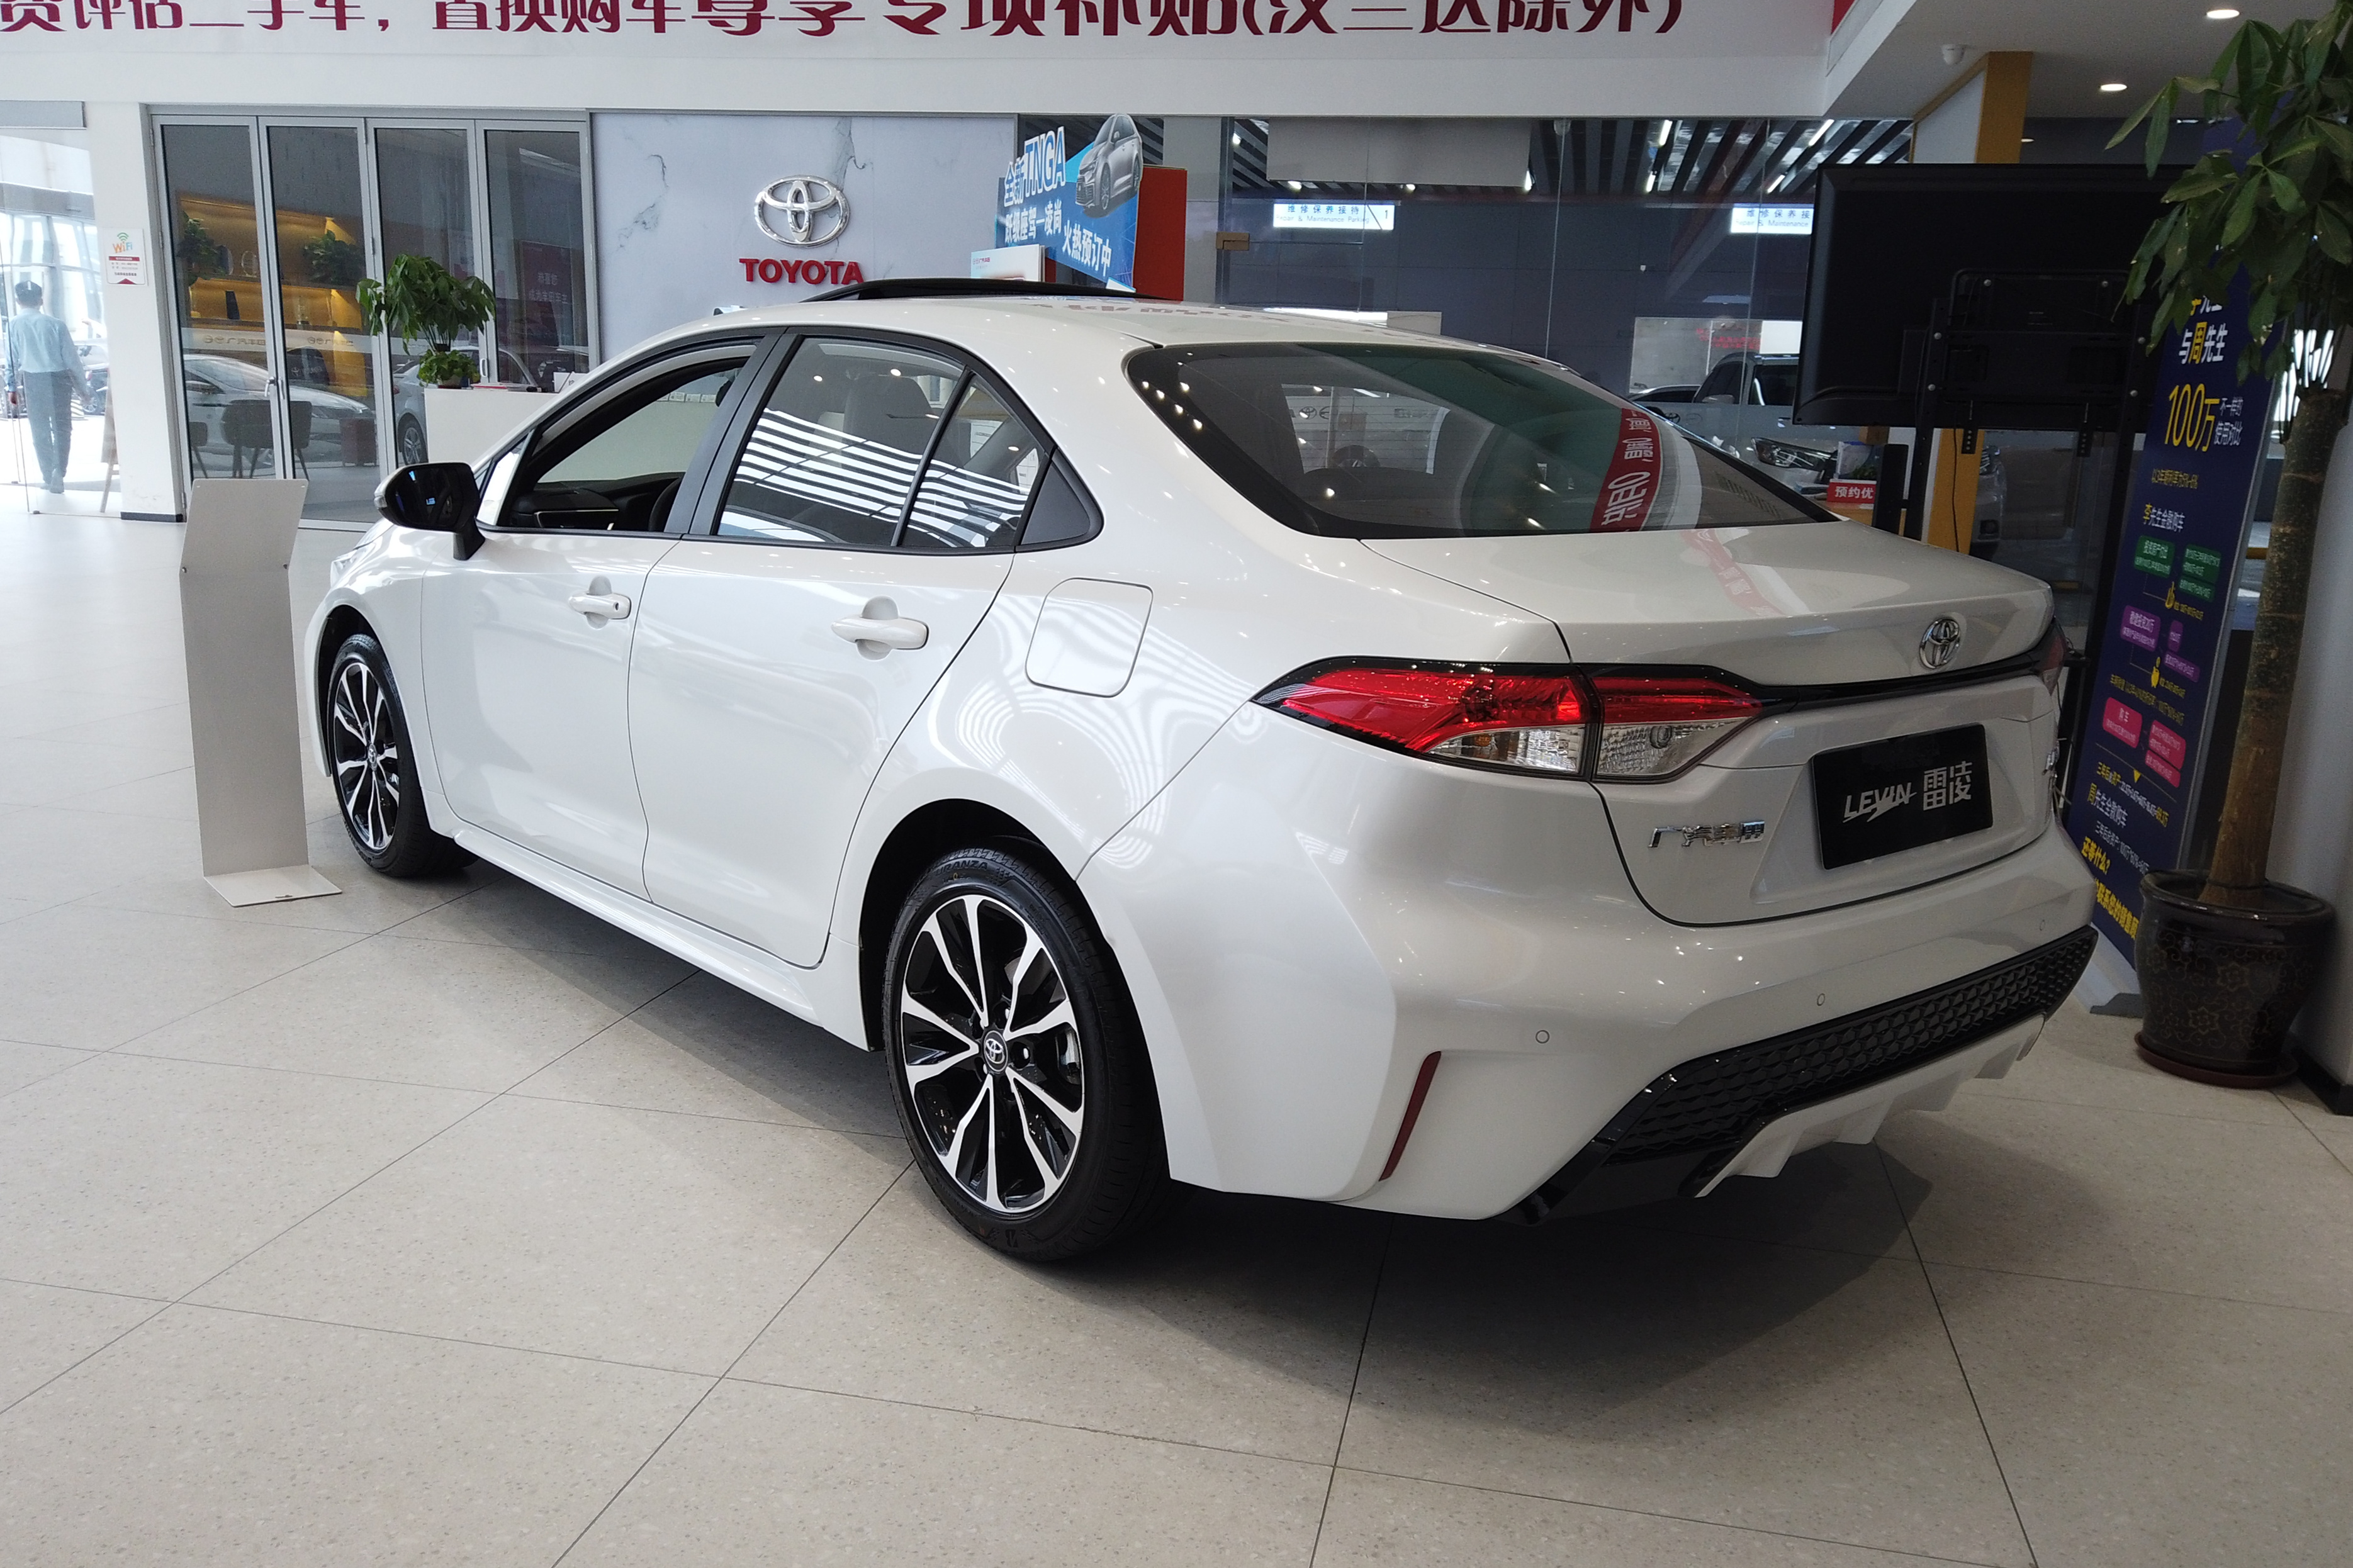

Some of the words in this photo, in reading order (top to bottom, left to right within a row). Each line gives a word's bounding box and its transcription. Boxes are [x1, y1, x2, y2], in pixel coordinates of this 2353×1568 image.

[112, 242, 133, 254] WiFi
[1062, 220, 1113, 277] 火热预订中
[739, 258, 864, 285] TOYOTA
[2179, 322, 2228, 364] 与周先生
[2164, 383, 2220, 452] 100万
[1834, 486, 1874, 499] 预约优
[1843, 782, 1918, 823] LEVIN
[1923, 761, 1973, 811] 雷凌
